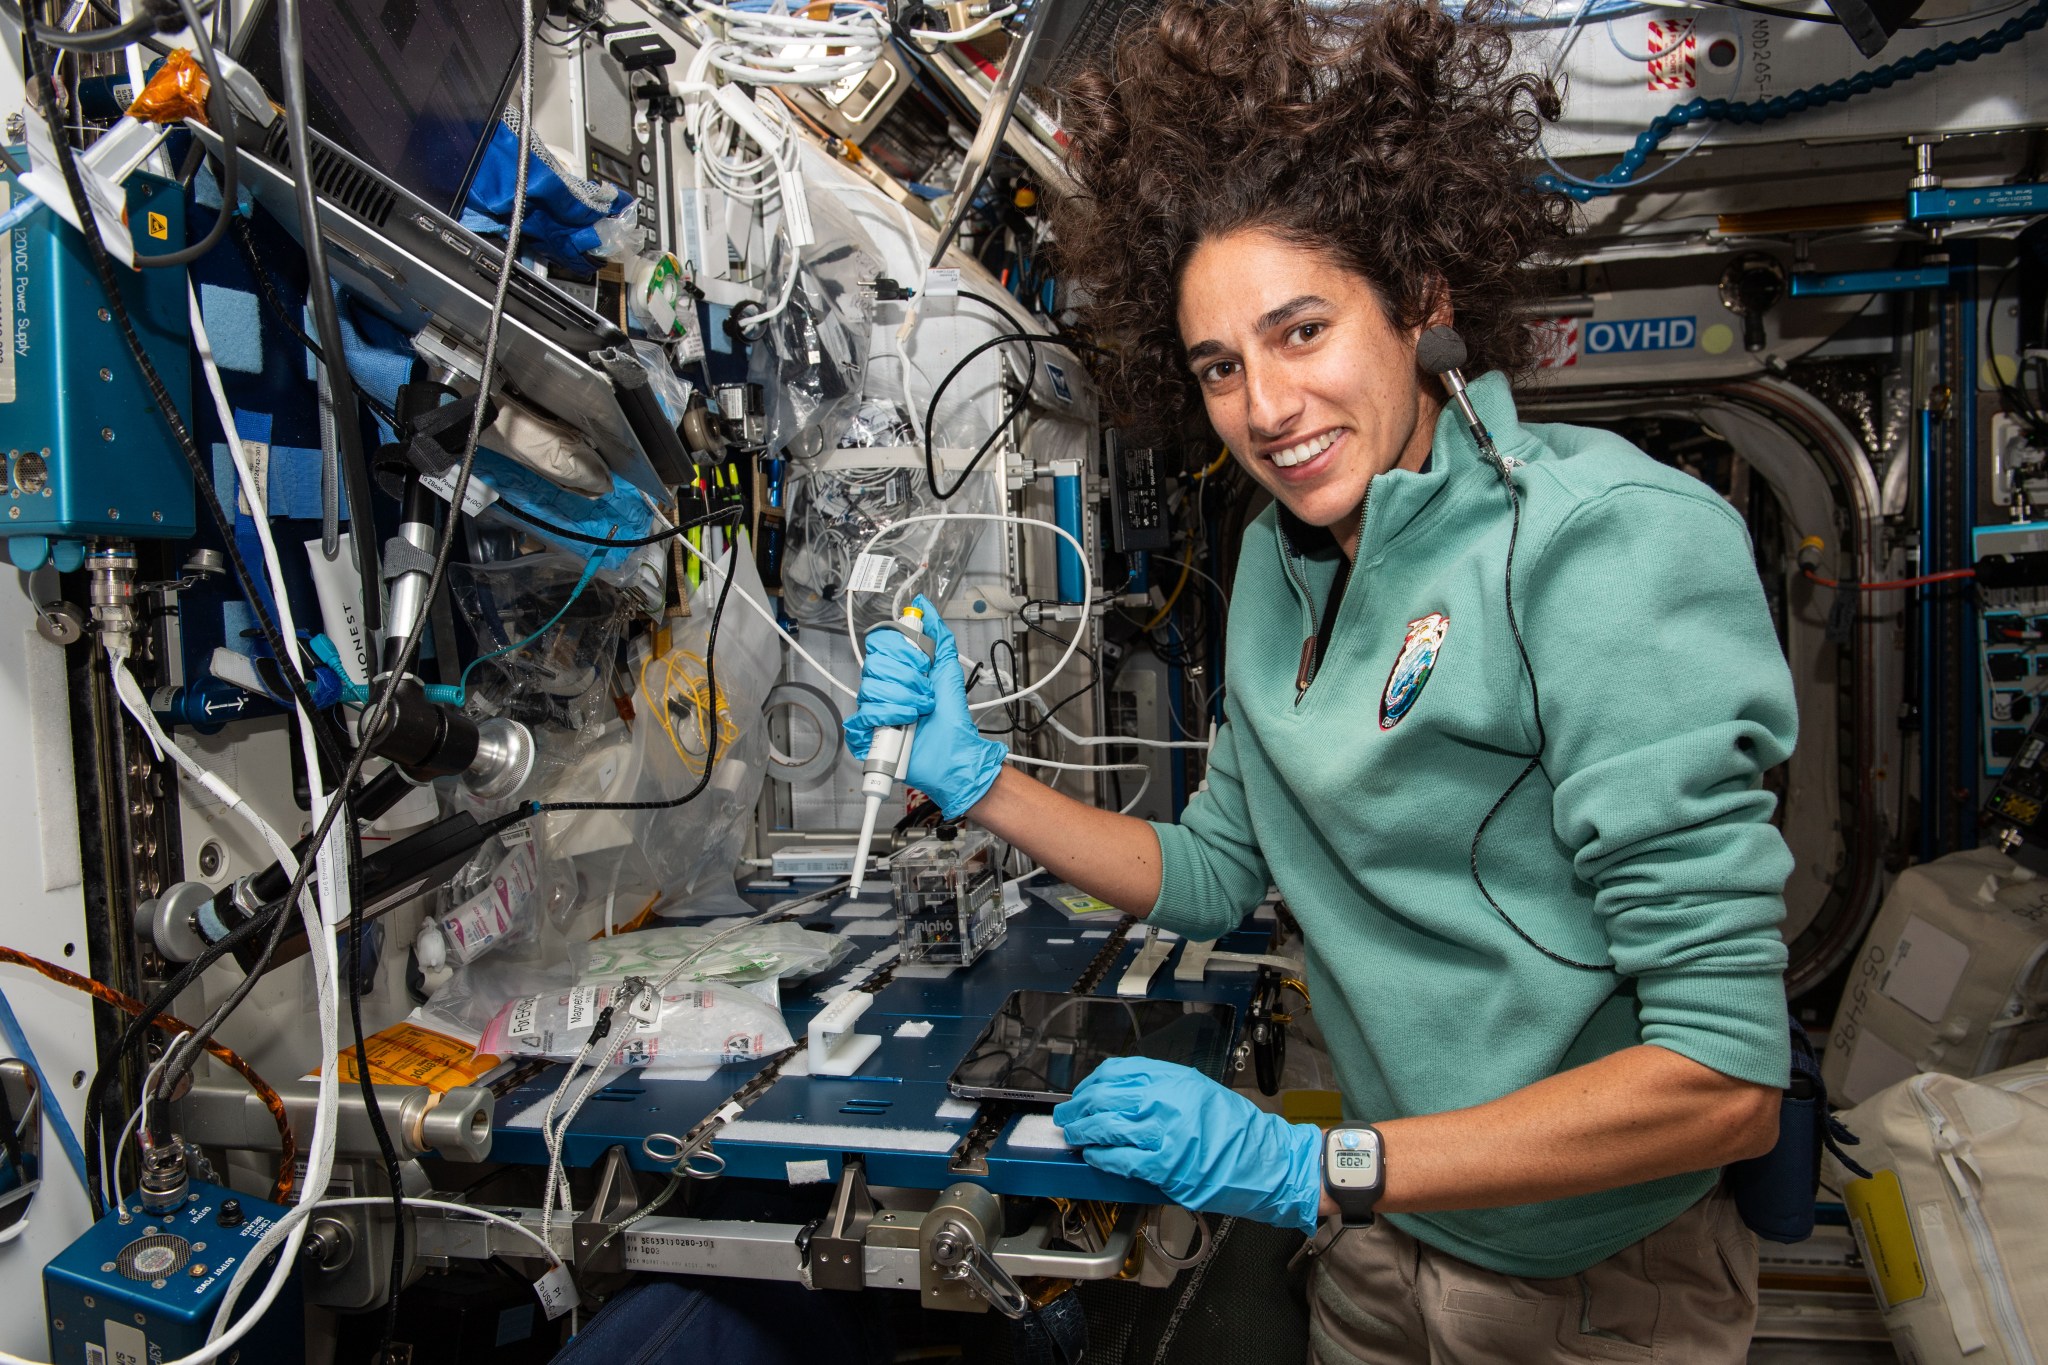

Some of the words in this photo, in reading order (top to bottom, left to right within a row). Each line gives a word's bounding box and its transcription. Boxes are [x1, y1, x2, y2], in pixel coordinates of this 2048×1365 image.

[14, 227, 28, 272] 120VDC
[16, 276, 29, 313] Power
[16, 318, 31, 357] Supply
[1588, 321, 1694, 353] OVHD
[427, 478, 445, 493] ZBook
[469, 499, 483, 509] (DC)
[344, 602, 368, 680] HONEST
[915, 919, 954, 932] mini16
[192, 1206, 212, 1225] OUTPUT
[239, 1215, 265, 1238] BREAKER
[249, 1219, 271, 1238] CIRCUIT
[216, 1257, 236, 1277] OUTPUT
[194, 1277, 215, 1295] POWER
